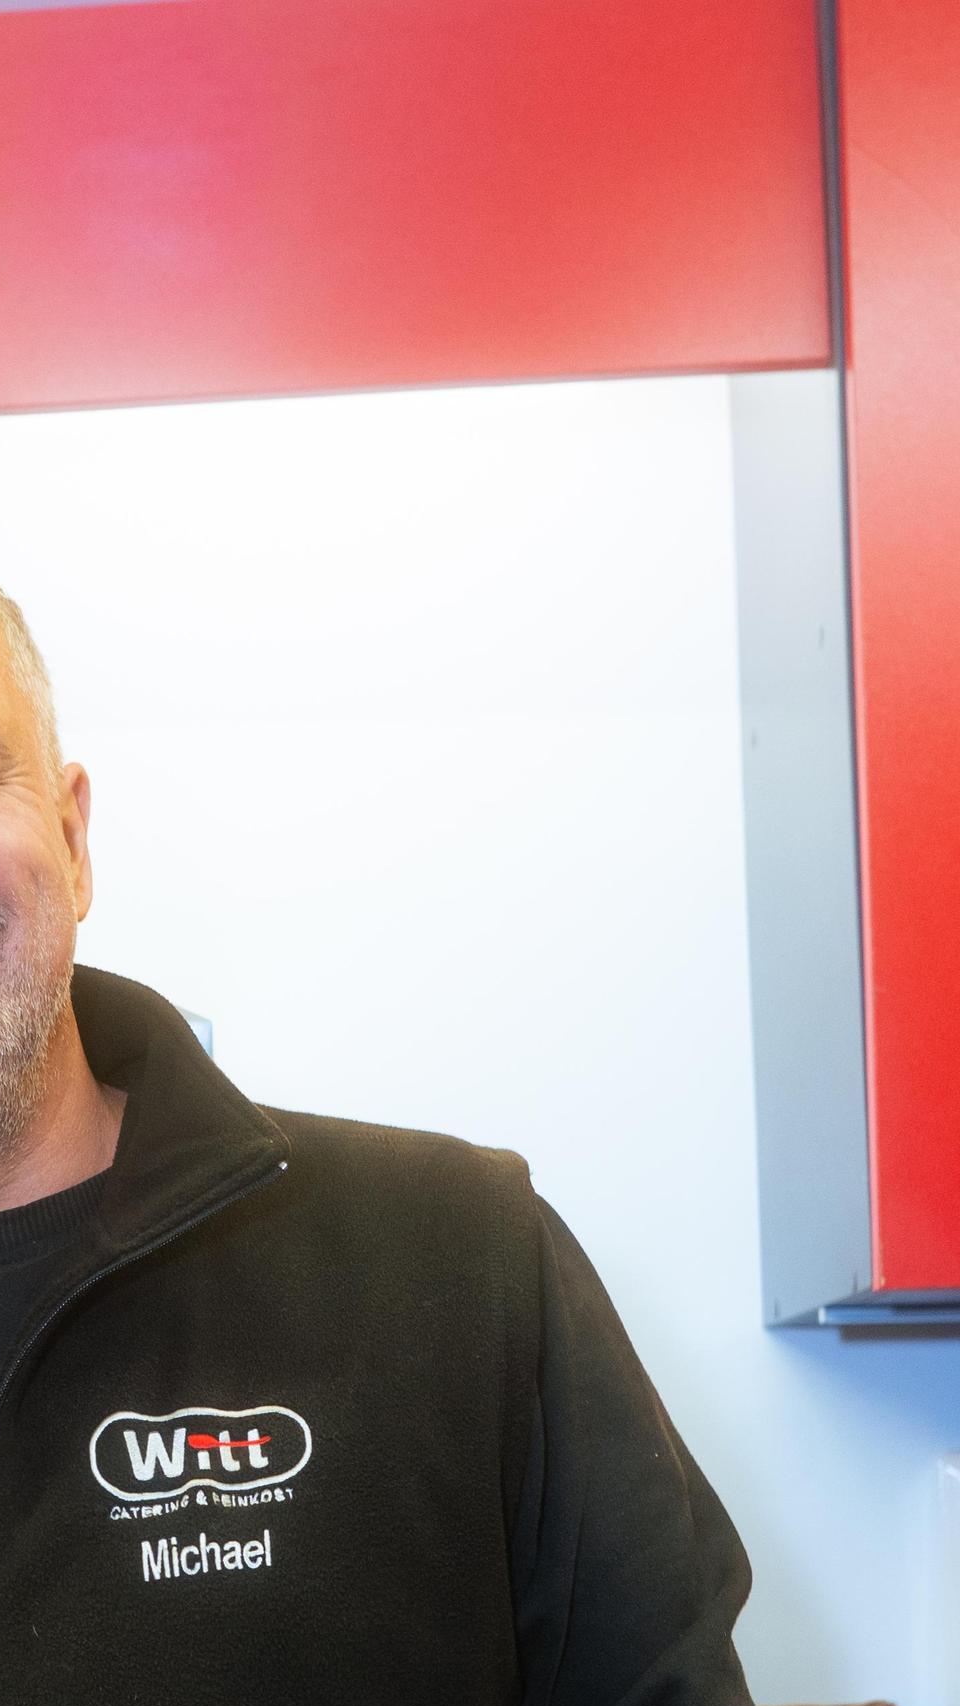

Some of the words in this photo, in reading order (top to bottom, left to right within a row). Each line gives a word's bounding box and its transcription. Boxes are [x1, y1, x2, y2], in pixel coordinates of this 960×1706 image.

[123, 1427, 271, 1482] Witt
[109, 1494, 190, 1521] CATERING
[195, 1489, 209, 1506] &
[212, 1487, 294, 1508] FEINKOST
[141, 1529, 272, 1582] Michael
